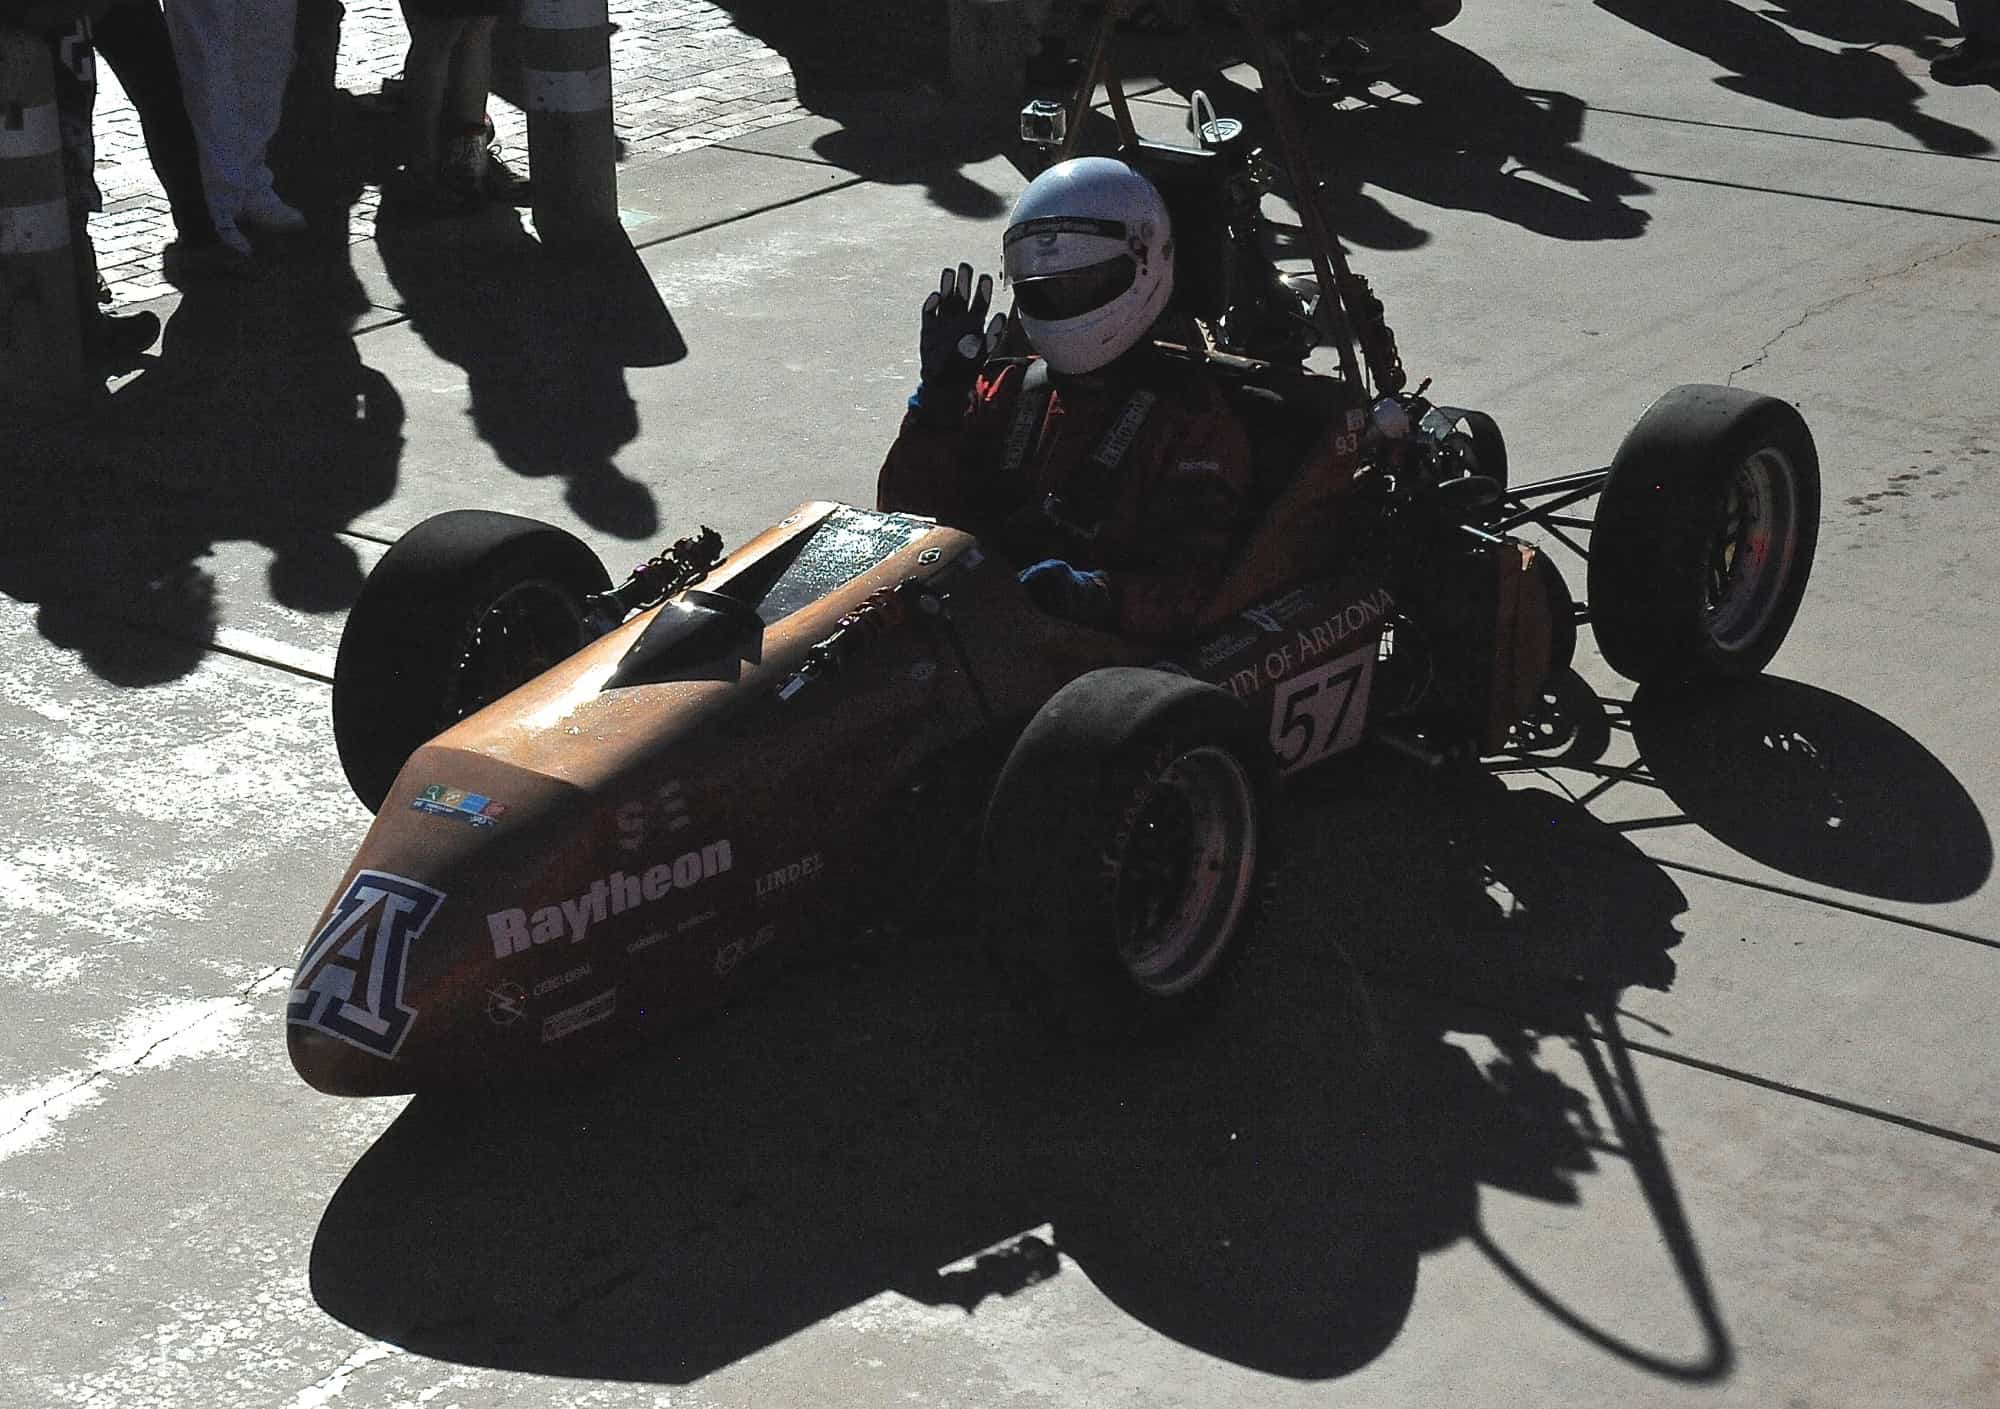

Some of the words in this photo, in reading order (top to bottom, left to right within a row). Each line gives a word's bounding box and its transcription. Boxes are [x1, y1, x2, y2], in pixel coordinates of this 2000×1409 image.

[1335, 432, 1359, 456] 93
[1265, 645, 1293, 679] OF
[1297, 587, 1395, 661] ARIZONA
[1278, 663, 1365, 773] 57
[486, 839, 734, 960] Raytheon
